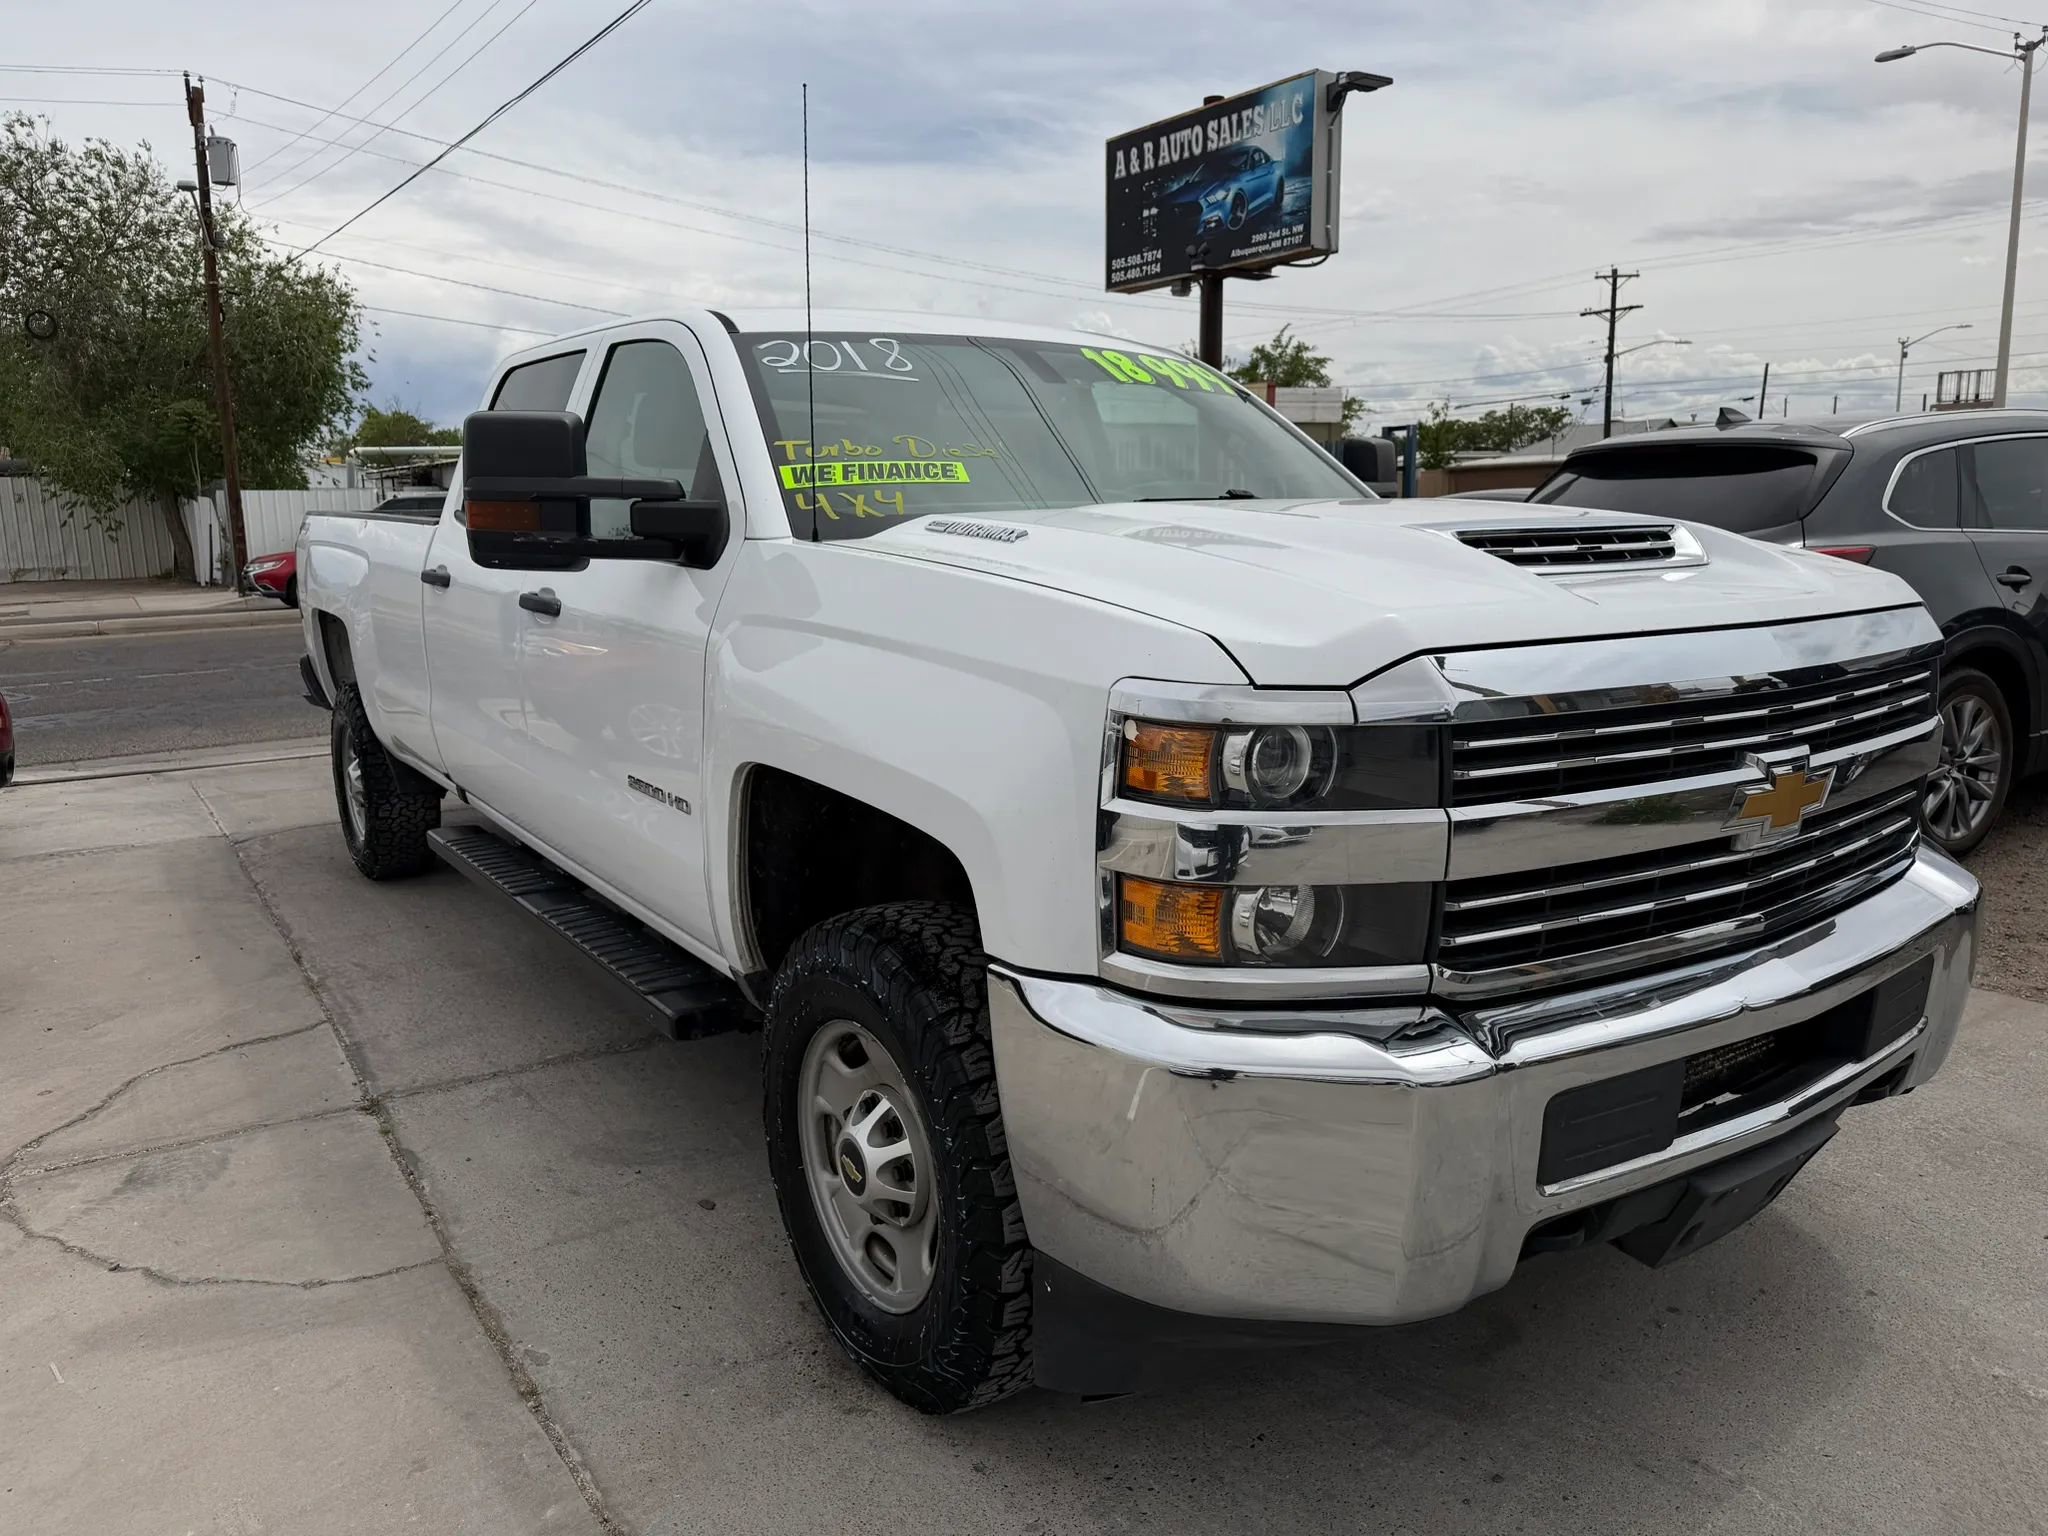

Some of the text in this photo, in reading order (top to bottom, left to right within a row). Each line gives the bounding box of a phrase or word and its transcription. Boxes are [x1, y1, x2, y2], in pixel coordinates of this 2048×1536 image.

[1114, 93, 1304, 180] A & R AUTO SALES LLC
[757, 337, 914, 373] 2018
[773, 438, 883, 461] Turbo
[791, 462, 960, 484] WE FINANCE
